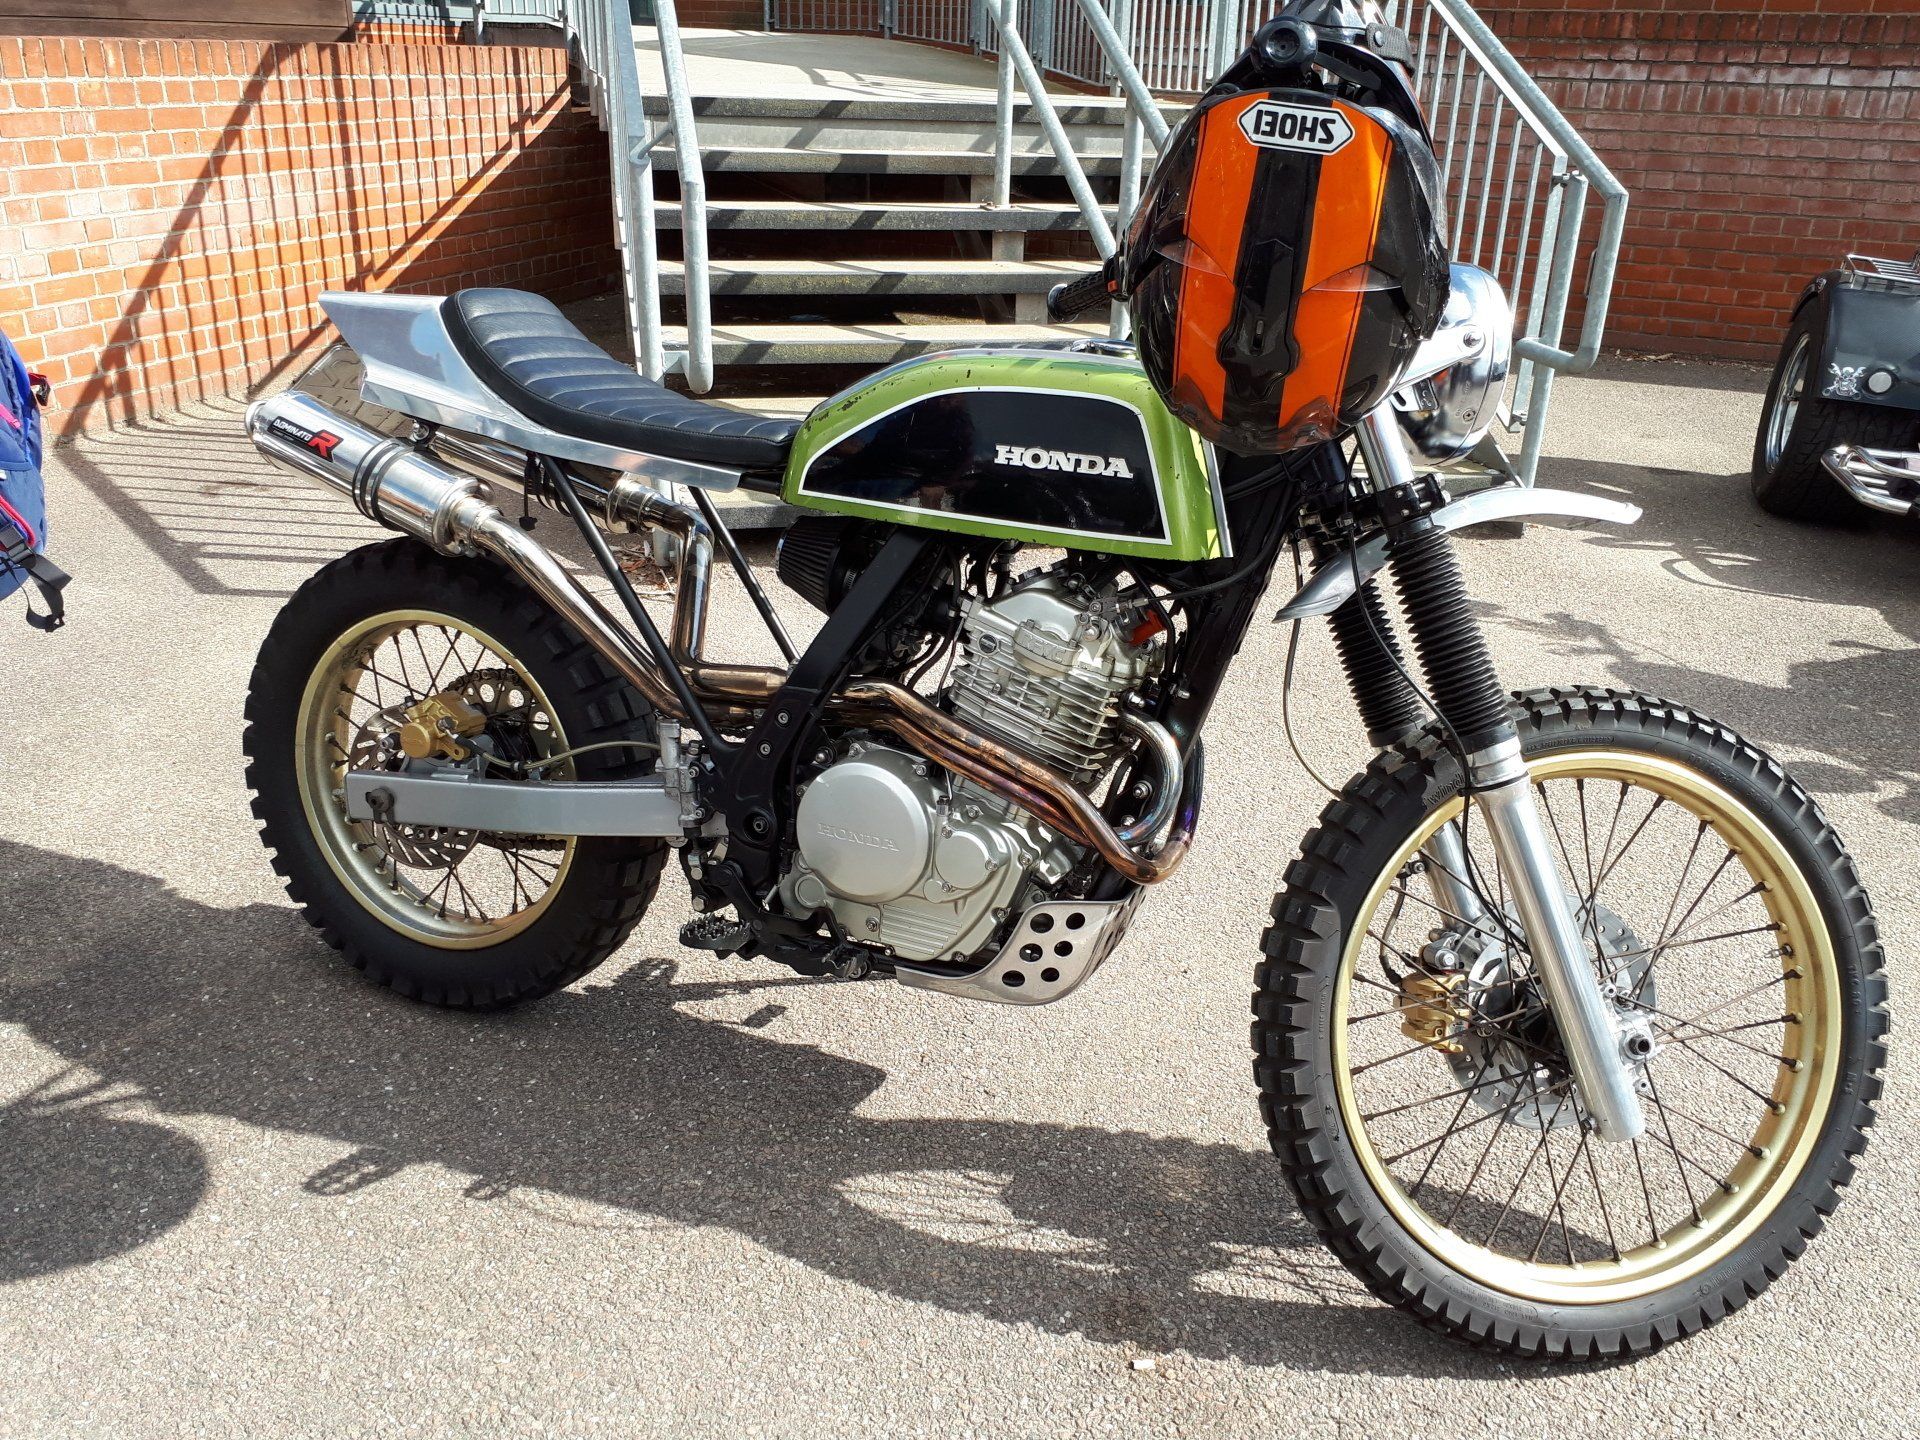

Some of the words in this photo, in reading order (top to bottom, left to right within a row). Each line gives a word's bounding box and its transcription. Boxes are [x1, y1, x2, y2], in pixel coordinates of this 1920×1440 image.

[1253, 109, 1337, 145] SHOEI
[994, 444, 1134, 479] HONDA
[816, 822, 901, 852] HONDA
